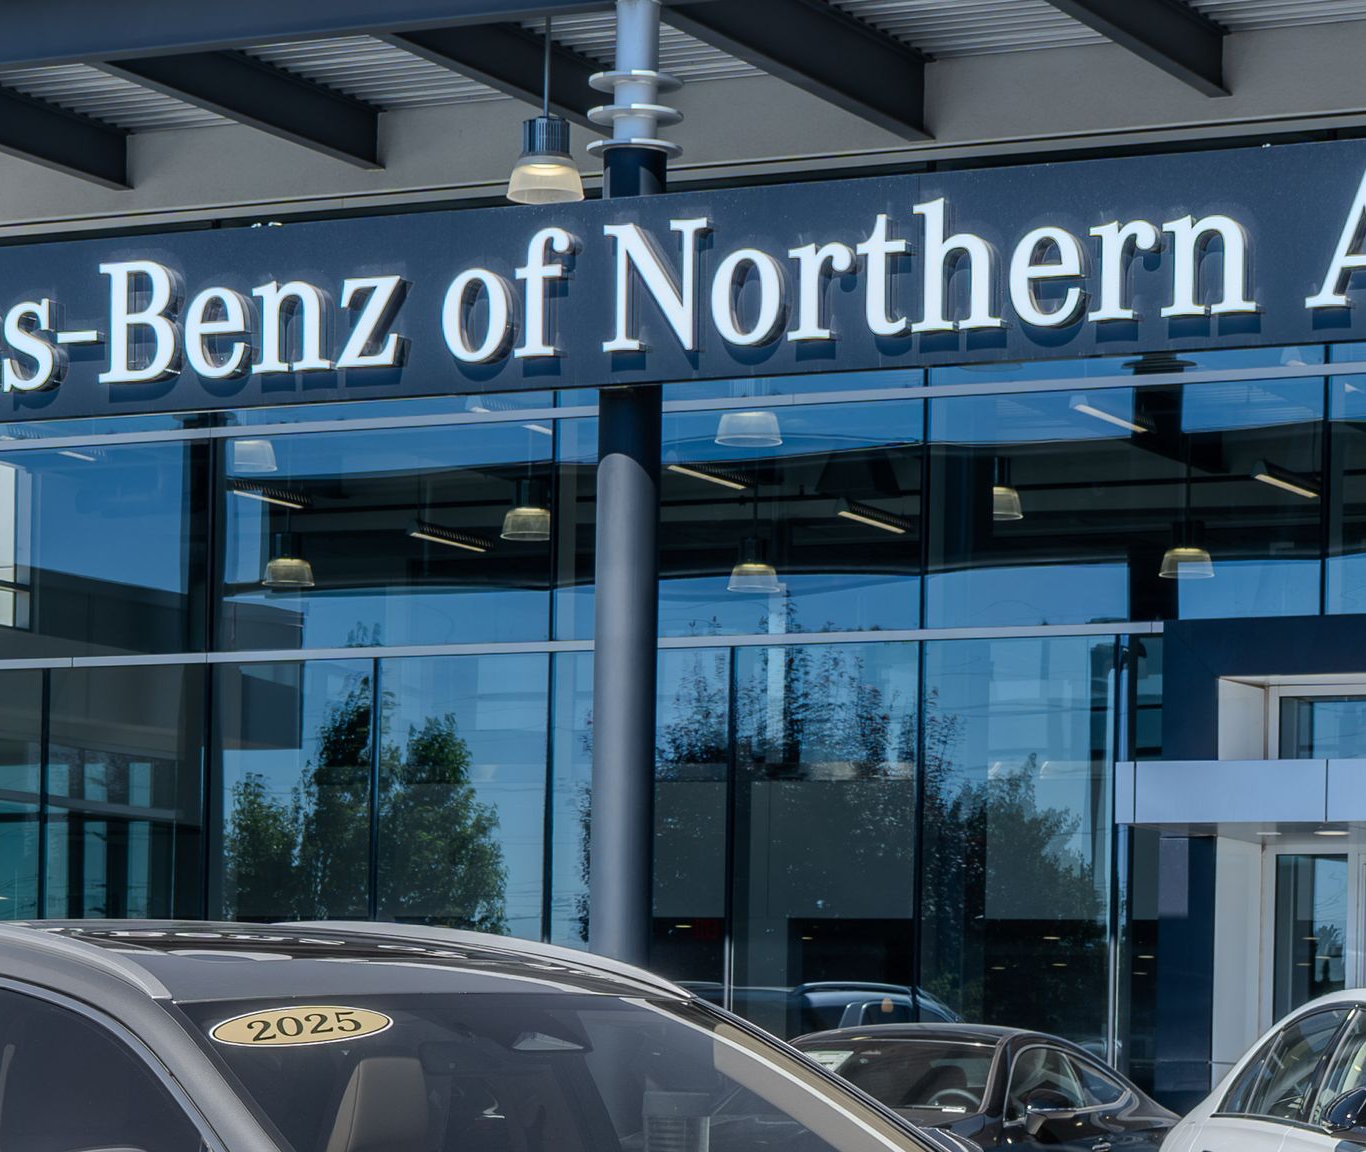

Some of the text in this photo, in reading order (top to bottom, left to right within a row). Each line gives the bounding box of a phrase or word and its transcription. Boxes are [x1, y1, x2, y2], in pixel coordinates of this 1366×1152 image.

[441, 225, 574, 364] of
[600, 196, 1261, 356] Northern
[246, 1011, 362, 1042] 2025
